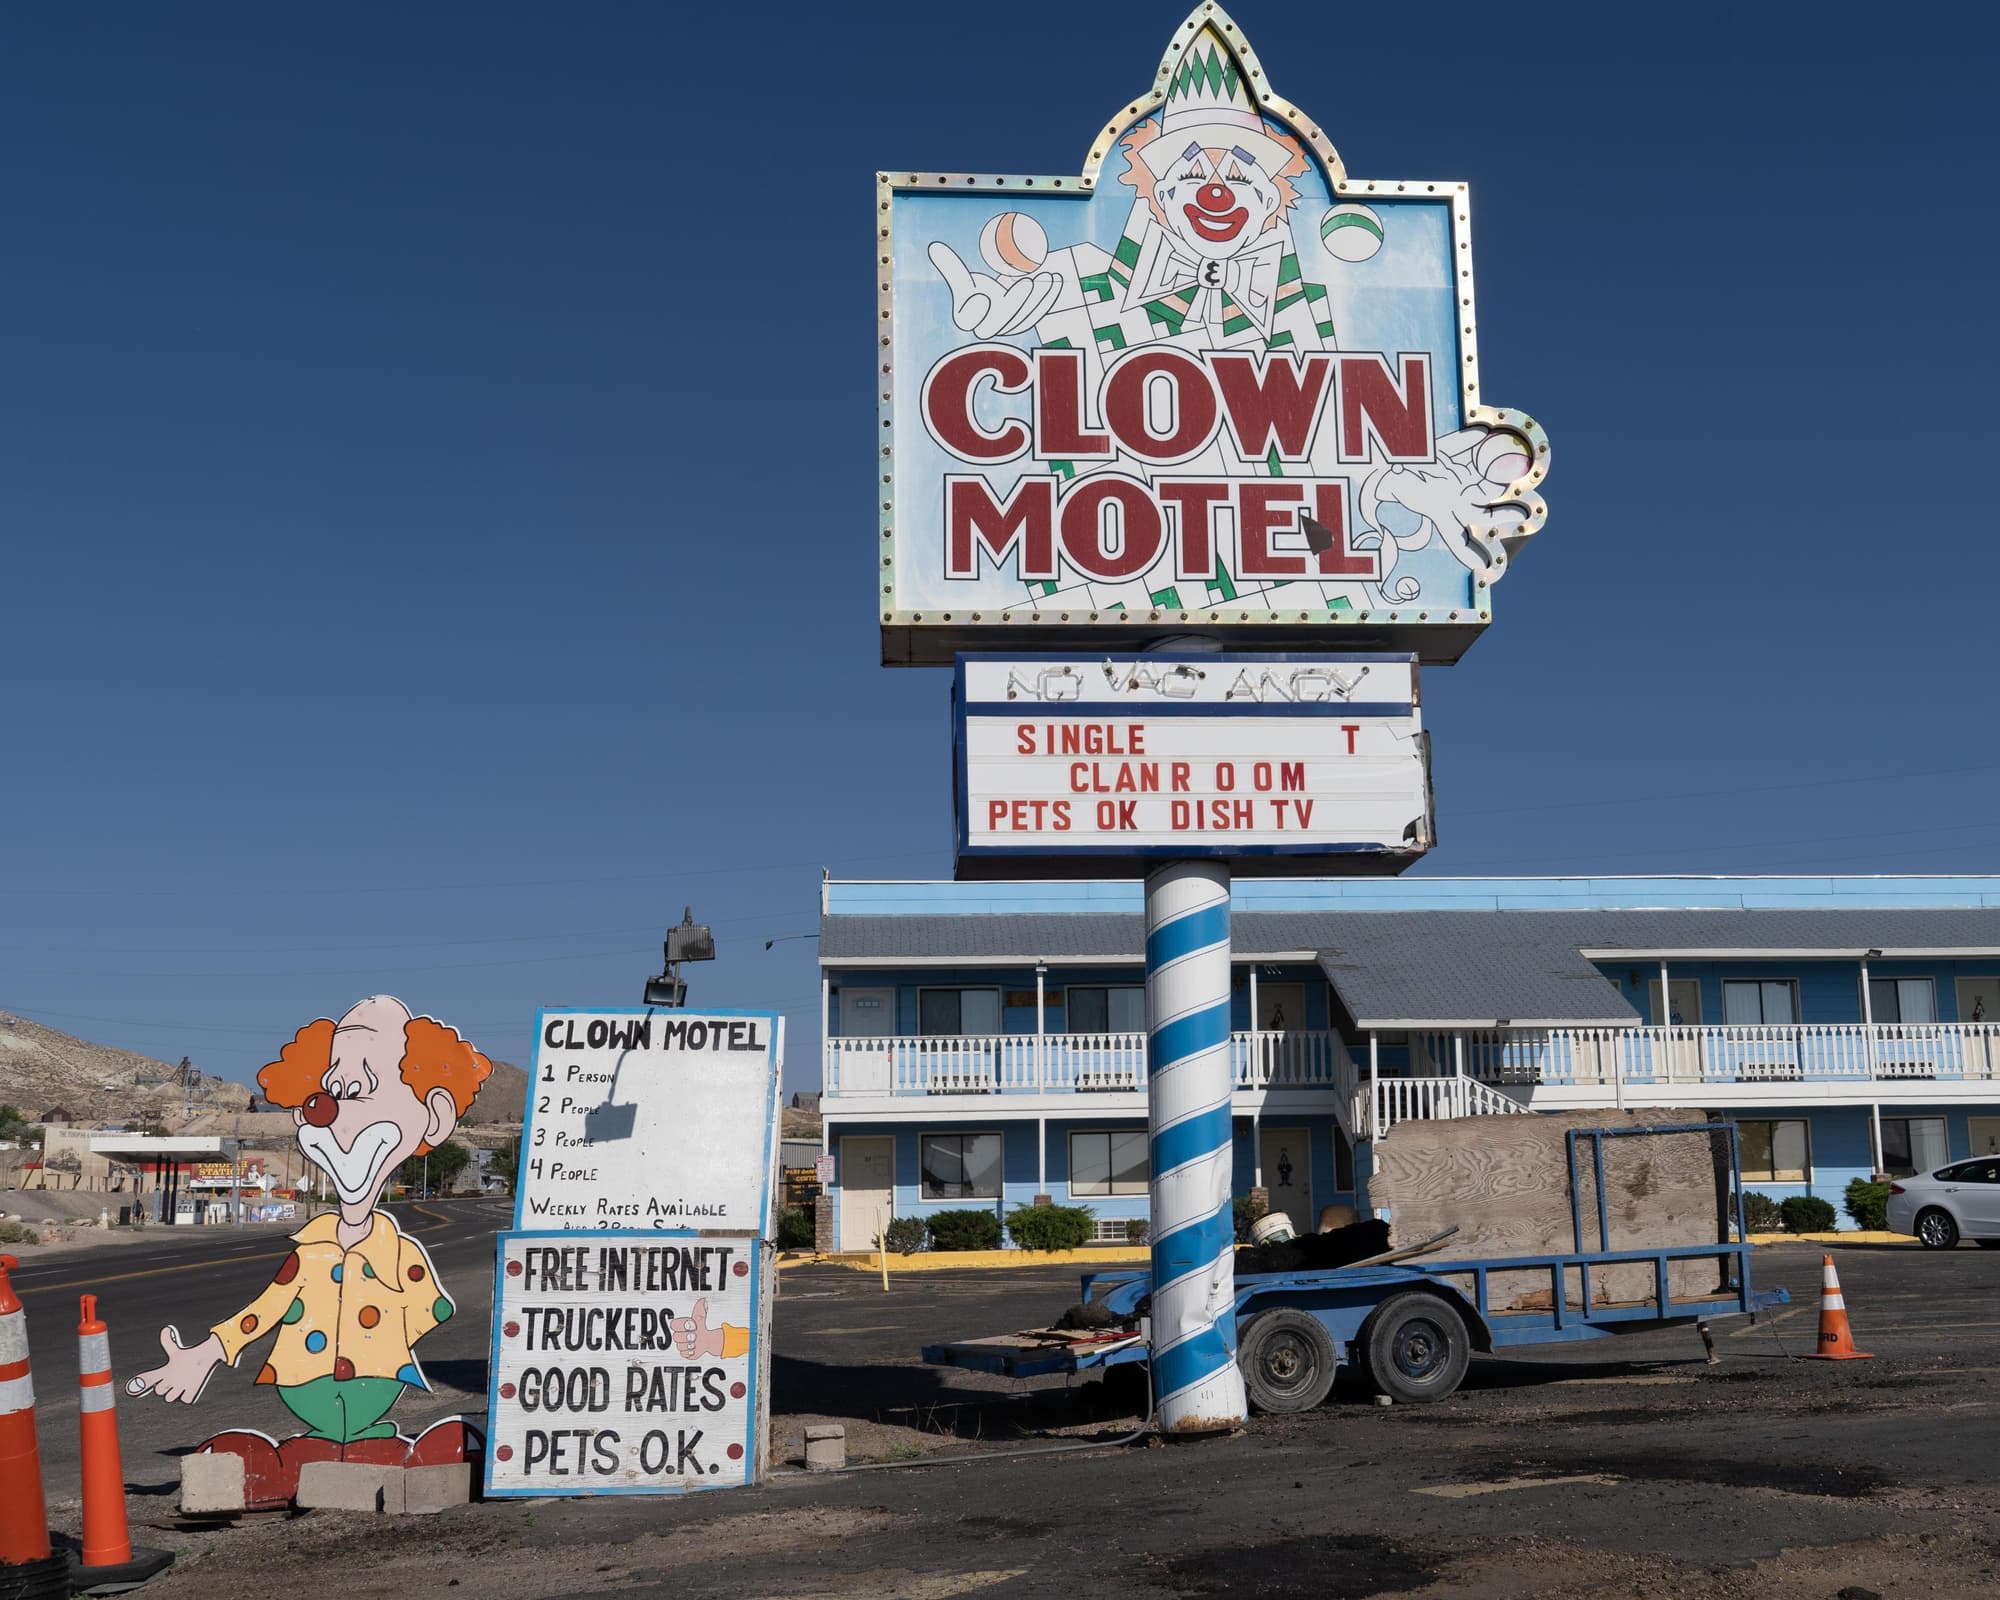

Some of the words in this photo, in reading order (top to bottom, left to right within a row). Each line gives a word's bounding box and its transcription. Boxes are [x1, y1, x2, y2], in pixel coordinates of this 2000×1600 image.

[921, 342, 1437, 465] CLOWN
[944, 472, 1382, 583] MOTEL
[1007, 664, 1084, 702] NO
[1017, 723, 1145, 755] SINGLE
[1341, 724, 1360, 755] T
[988, 799, 1072, 831] PETS
[1096, 800, 1138, 831] OK
[1171, 799, 1254, 830] DISH
[1270, 799, 1313, 830] TV
[544, 1019, 651, 1050] CLOWN
[664, 1020, 766, 1052] MOTEL
[541, 1064, 555, 1082] 1
[567, 1065, 614, 1082] PERSON
[538, 1095, 550, 1113] 2
[561, 1097, 600, 1115] PEOPLE
[534, 1127, 546, 1146] 3
[556, 1131, 595, 1147] PEOPLE
[198, 1160, 248, 1168] TONOPH
[530, 1158, 543, 1180] 4
[551, 1163, 599, 1181] PEOPLE
[530, 1197, 587, 1216] WEEKLY
[597, 1198, 640, 1216] RATES
[524, 1246, 591, 1292] FREE
[600, 1246, 734, 1292] INTERNET
[522, 1307, 675, 1352] TRUCKERS
[518, 1366, 611, 1413] GOOD
[624, 1366, 727, 1413] RATES
[524, 1429, 621, 1475] PETS
[639, 1428, 720, 1476] O.K.
